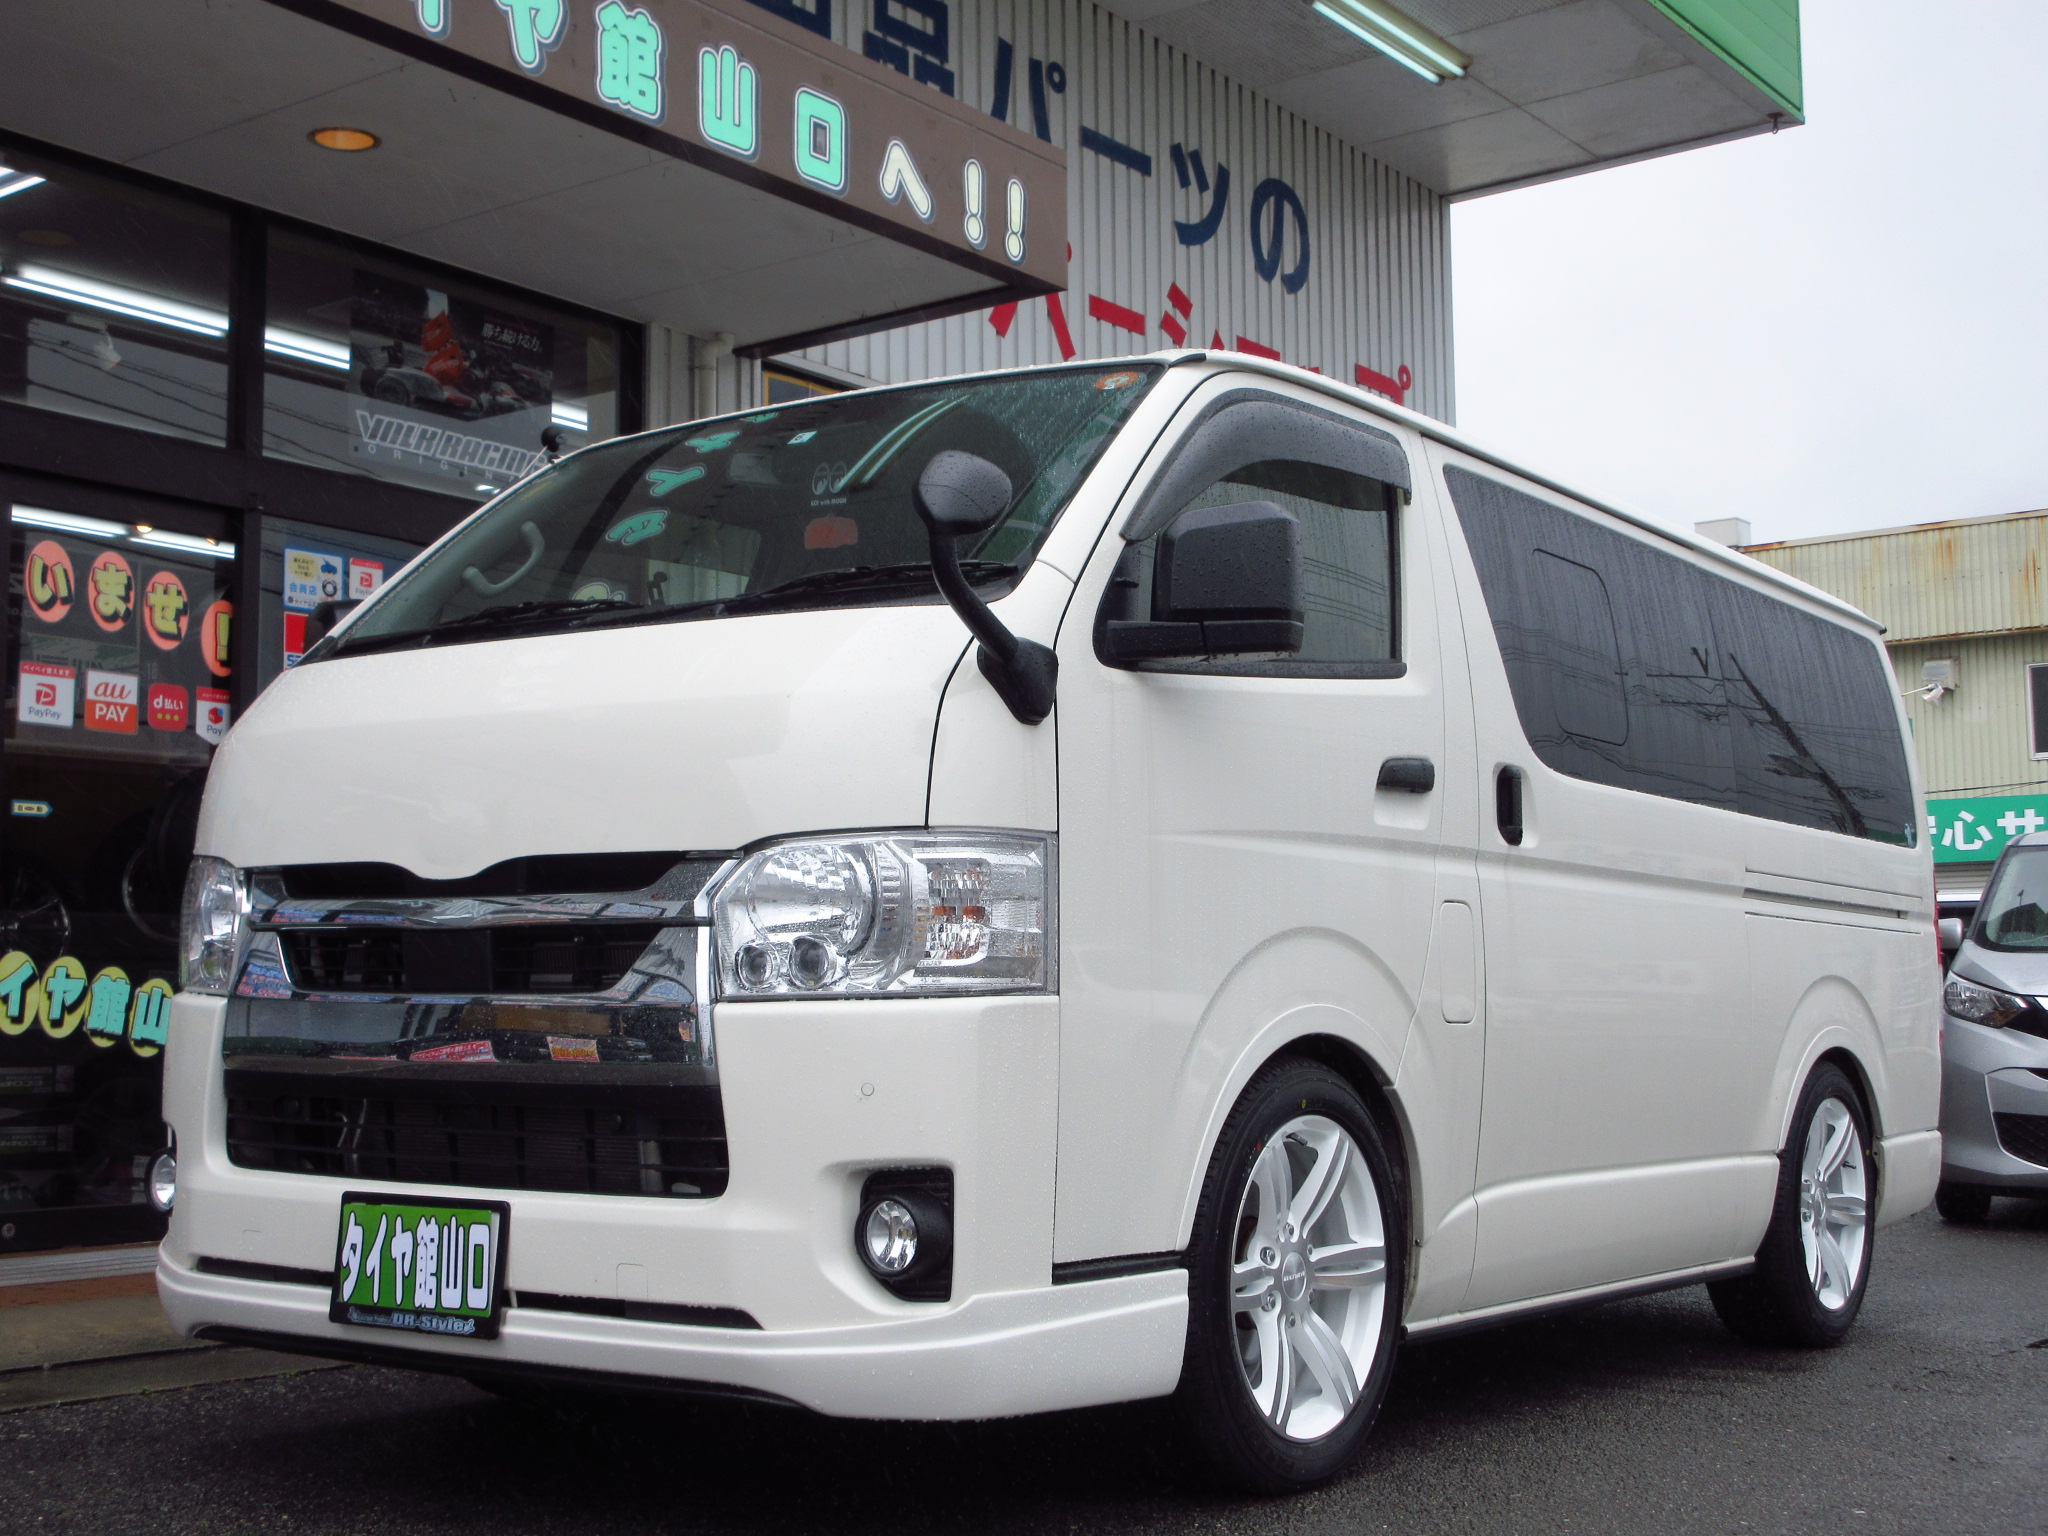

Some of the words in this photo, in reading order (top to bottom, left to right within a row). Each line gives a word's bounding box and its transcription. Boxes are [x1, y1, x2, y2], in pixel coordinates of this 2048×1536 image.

[94, 681, 131, 700] au
[28, 706, 61, 720] PayPay
[95, 703, 129, 722] PAY
[207, 724, 222, 736] Pay
[1927, 808, 2045, 851] 心サ
[342, 1211, 490, 1310] タイヤ館山口
